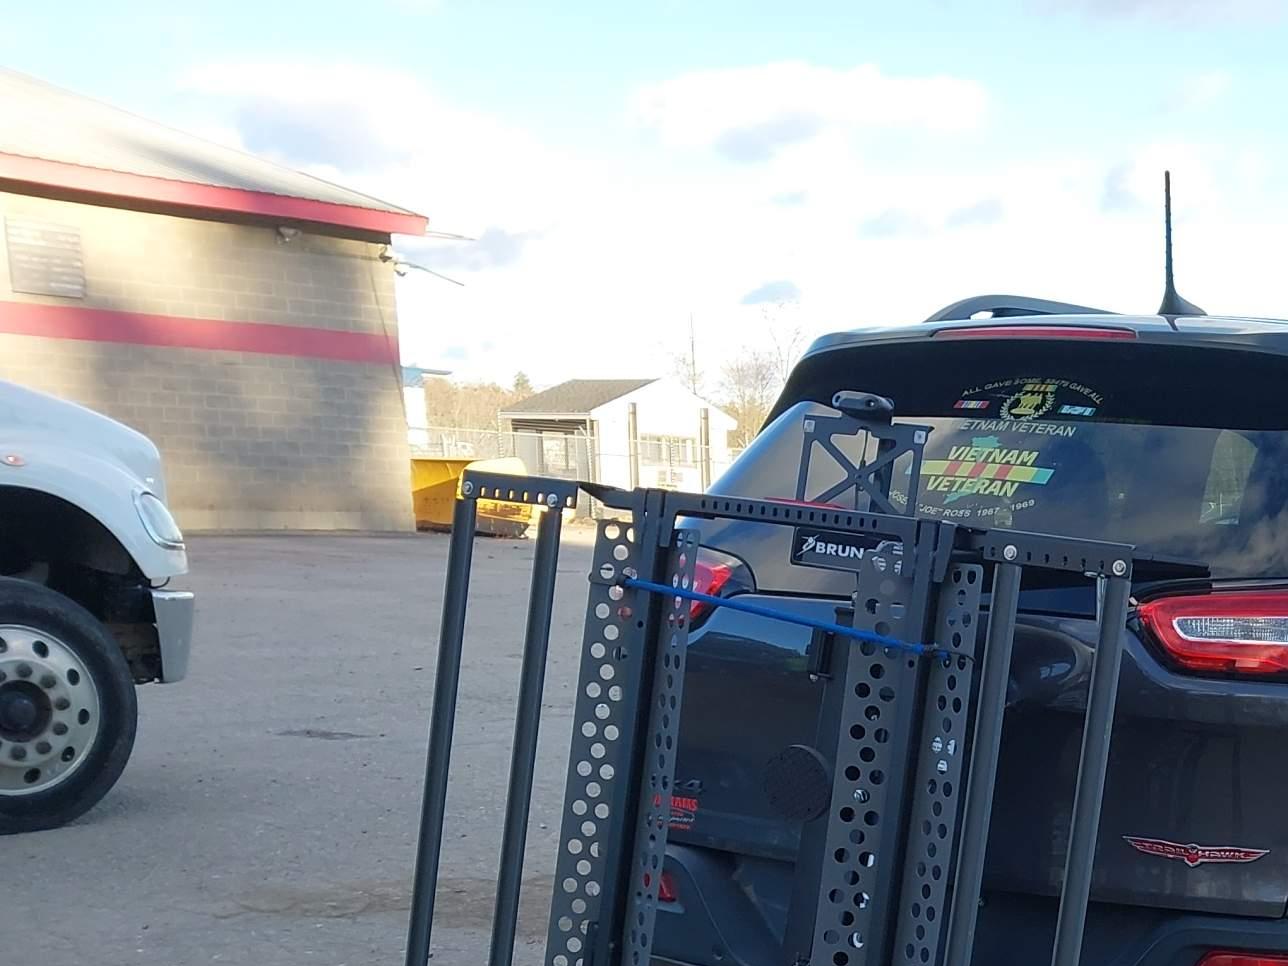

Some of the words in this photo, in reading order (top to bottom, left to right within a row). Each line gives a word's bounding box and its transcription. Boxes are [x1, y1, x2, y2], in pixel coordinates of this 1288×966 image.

[962, 387, 982, 397] ALL
[984, 380, 1012, 391] GAVE
[1069, 382, 1092, 396] GAVE
[1090, 391, 1104, 405] ALL
[1012, 422, 1076, 437] VETERAN
[948, 445, 1039, 466] VIETNAM
[926, 475, 1020, 497] VETERAN
[943, 507, 971, 518] ROSS
[1010, 499, 1036, 512] 1969
